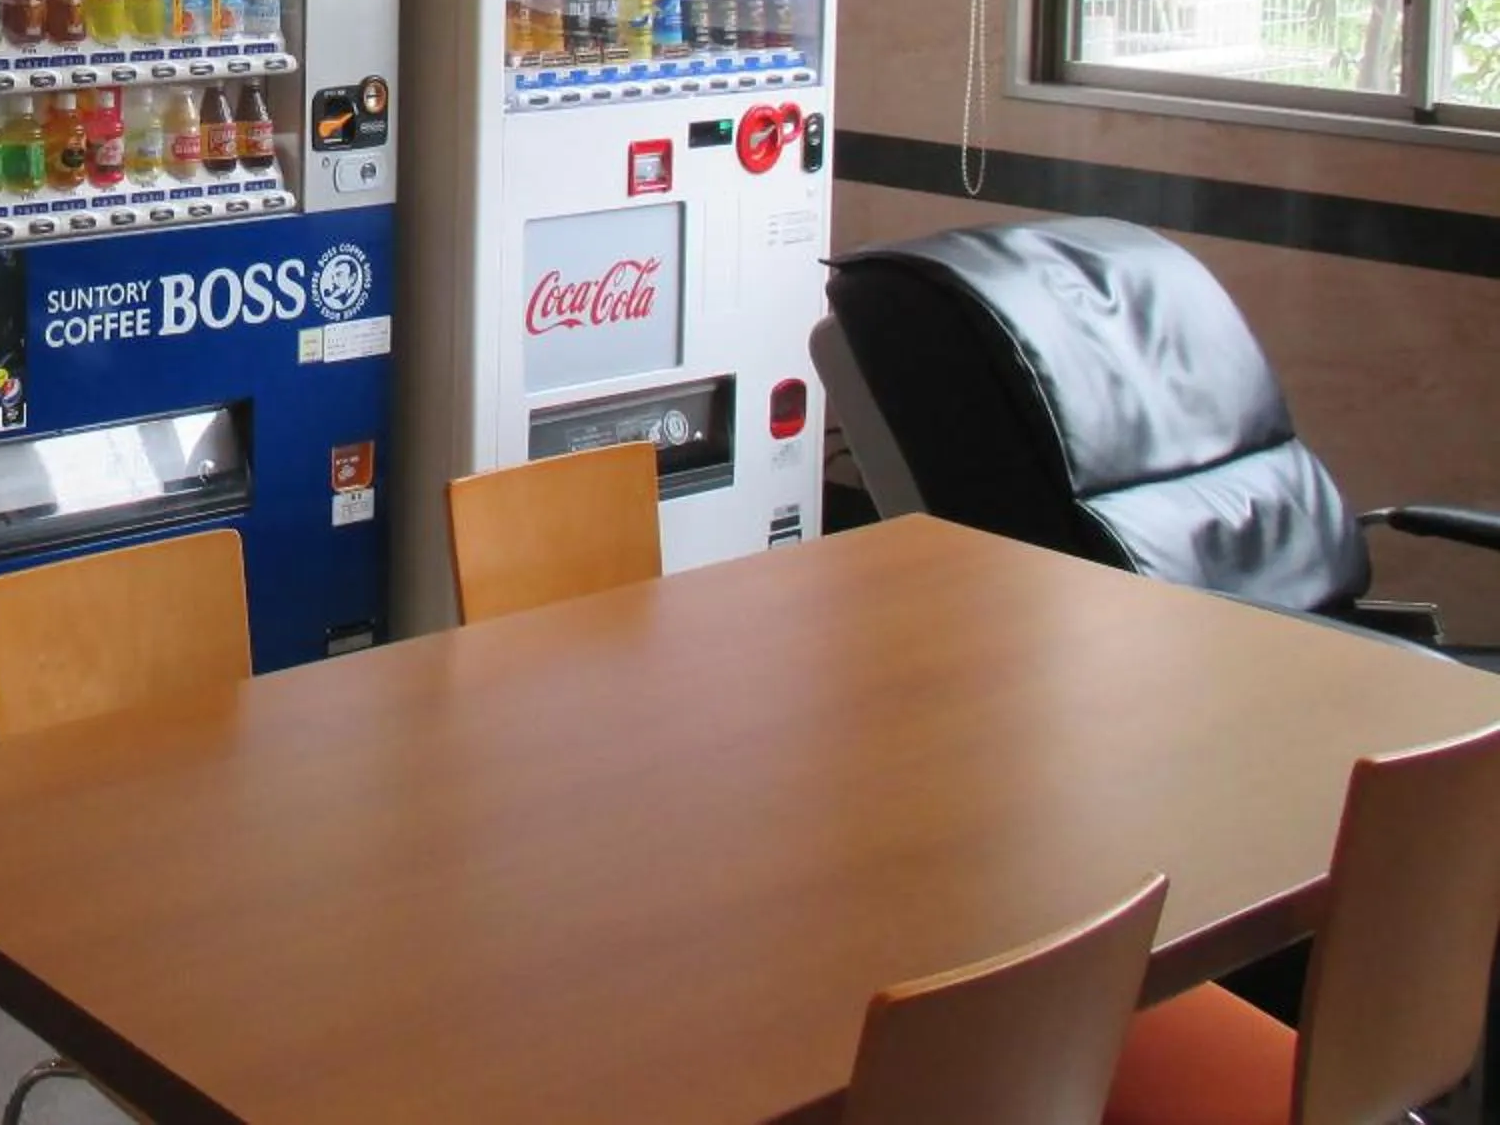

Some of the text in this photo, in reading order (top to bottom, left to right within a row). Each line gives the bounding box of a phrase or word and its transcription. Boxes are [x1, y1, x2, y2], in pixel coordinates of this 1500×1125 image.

[46, 279, 152, 315] SUNTORY
[158, 258, 307, 336] BOSS
[525, 258, 661, 336] Coca-Cola
[45, 308, 151, 348] COFFEE
